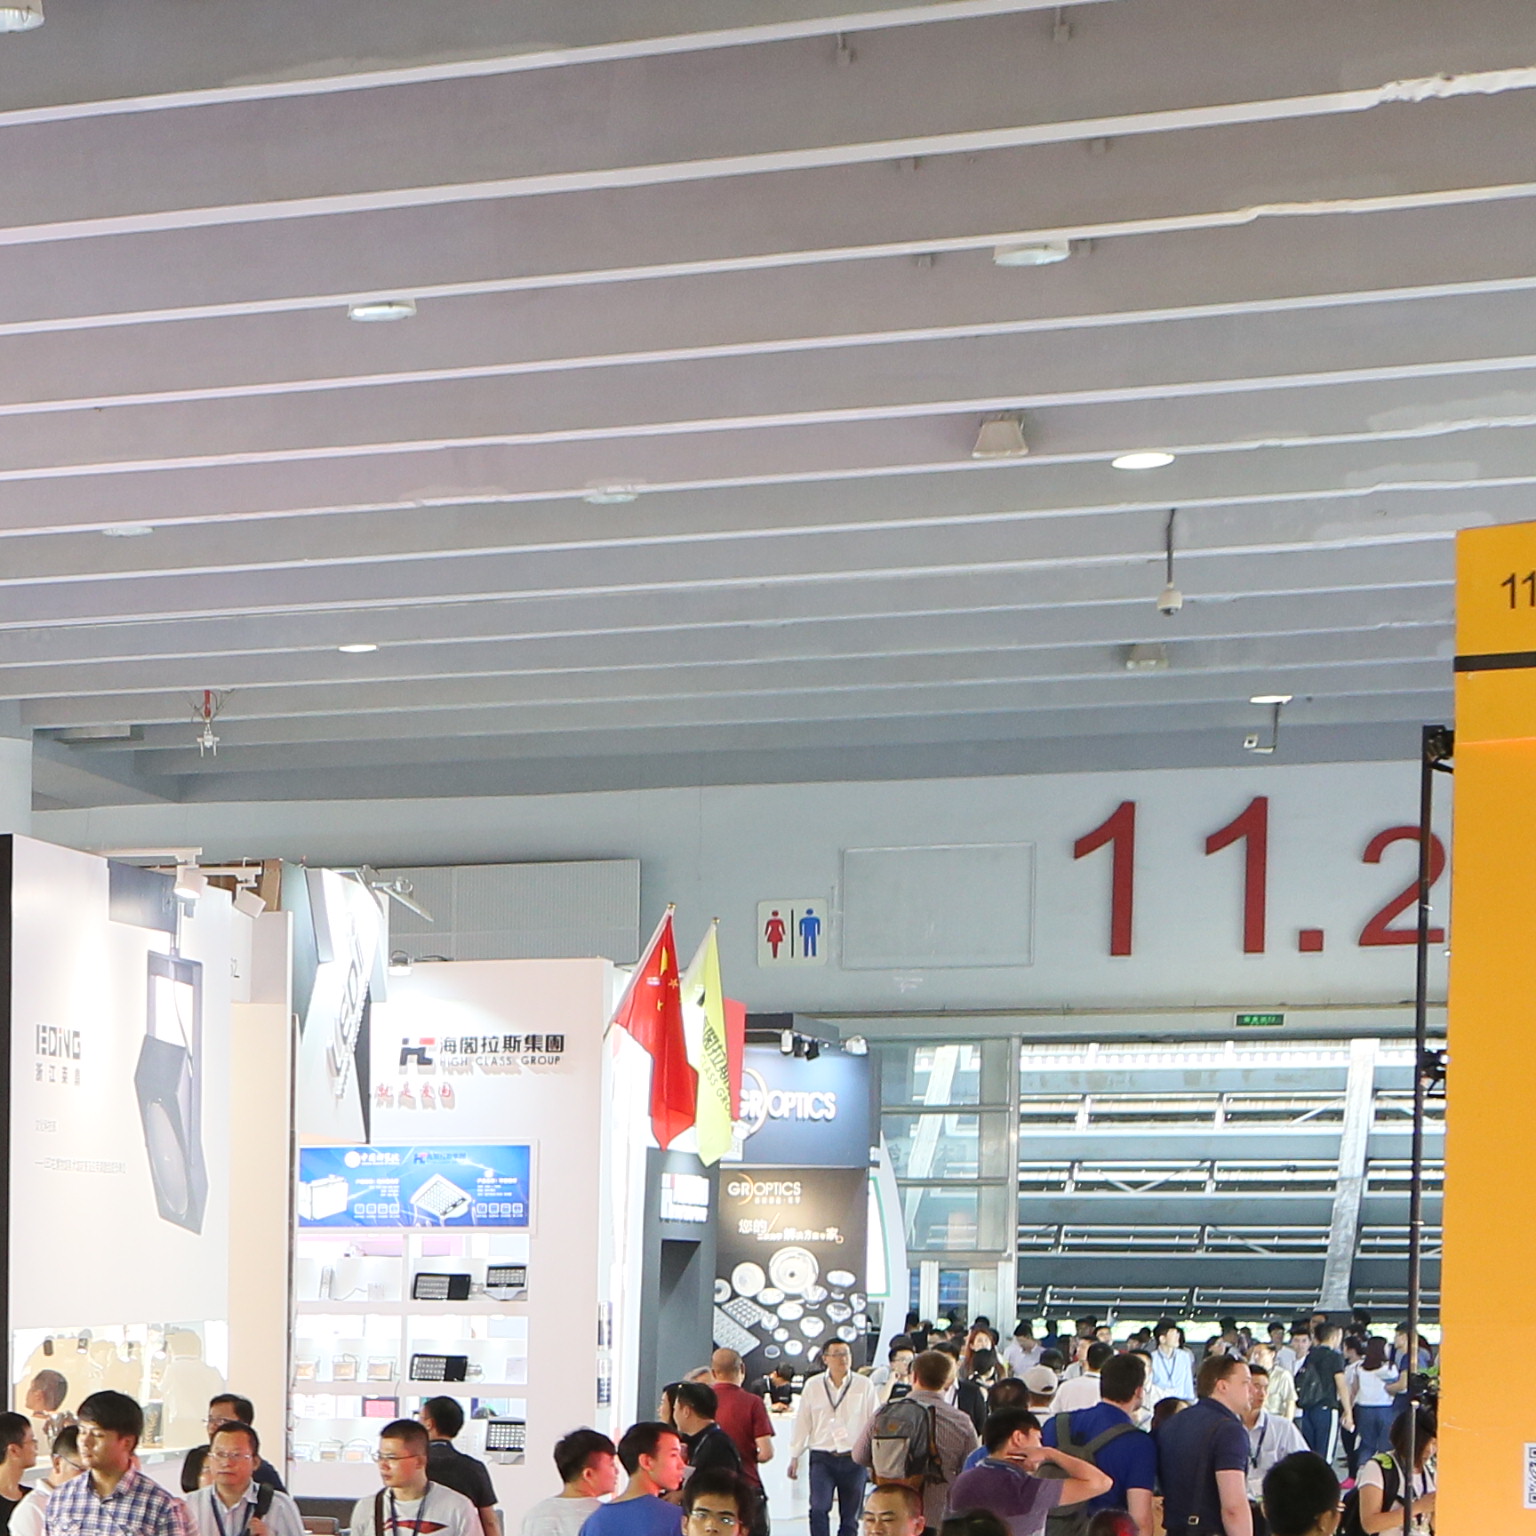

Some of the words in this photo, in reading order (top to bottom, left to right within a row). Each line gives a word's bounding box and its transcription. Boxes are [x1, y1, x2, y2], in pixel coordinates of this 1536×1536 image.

[1073, 796, 1446, 956] 11.2
[476, 1056, 512, 1066] CLASS
[521, 1055, 561, 1065] GROUP
